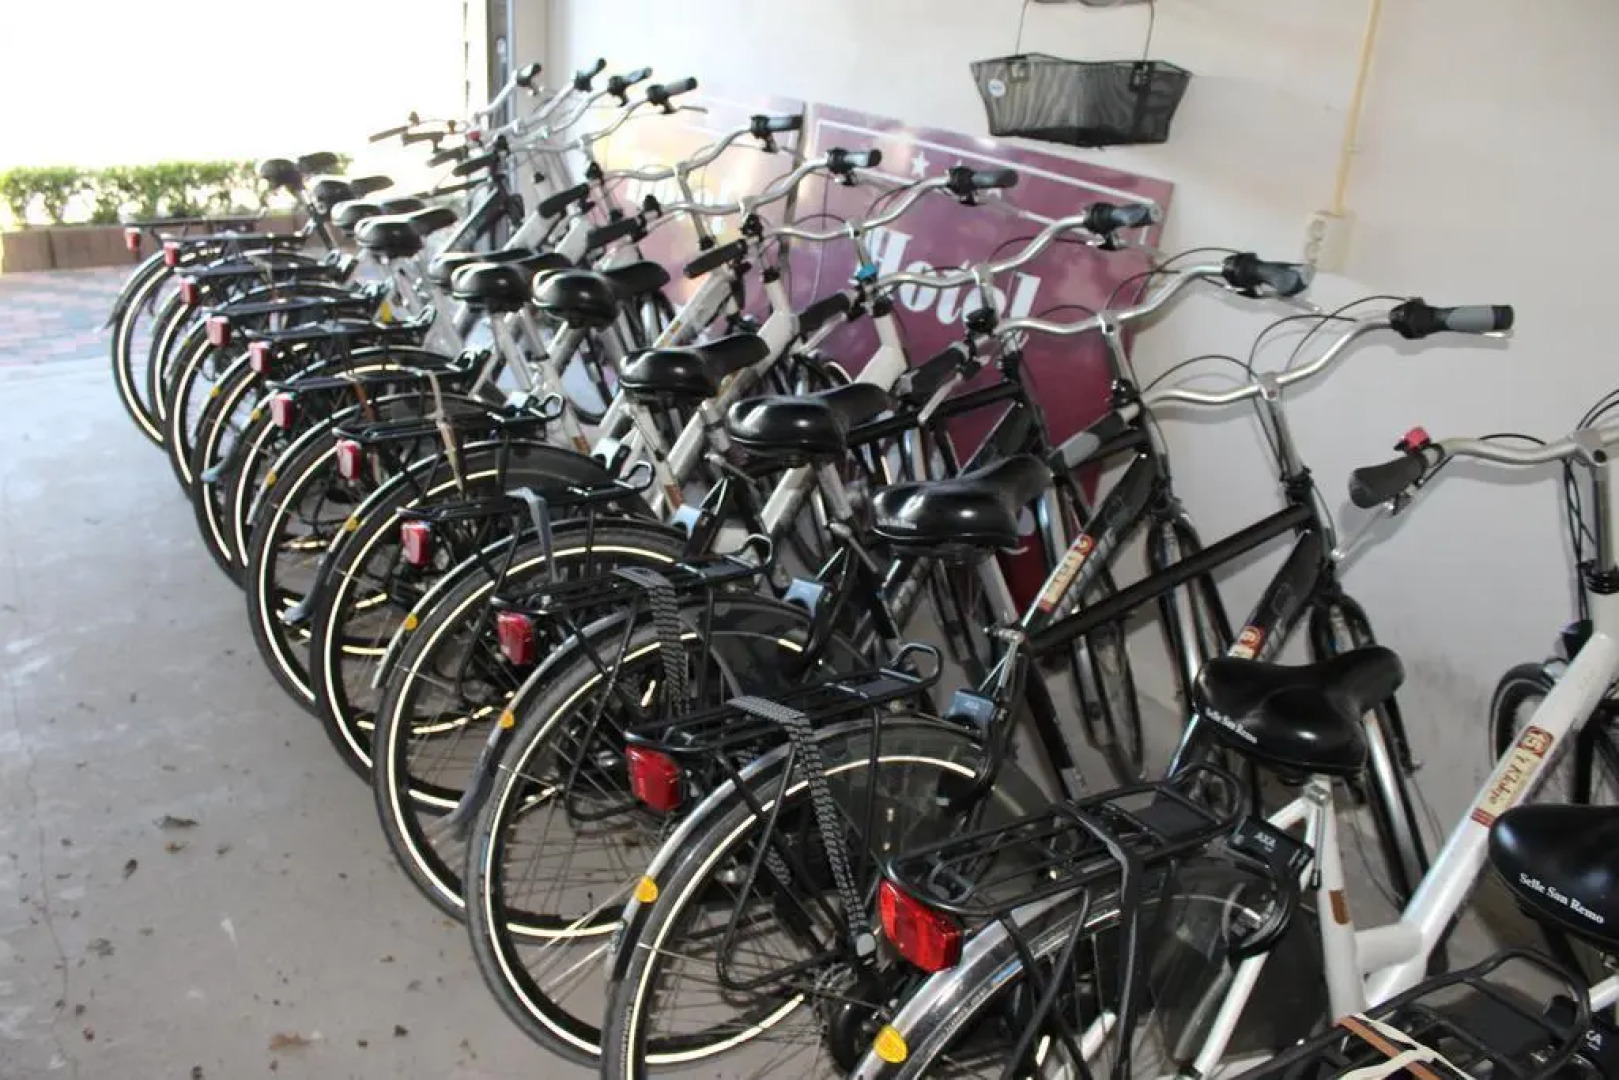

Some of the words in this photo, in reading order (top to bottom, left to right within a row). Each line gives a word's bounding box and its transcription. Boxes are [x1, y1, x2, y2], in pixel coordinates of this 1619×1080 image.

[1520, 872, 1546, 894] Selle
[1546, 886, 1568, 906] San
[1569, 897, 1604, 925] Remo
